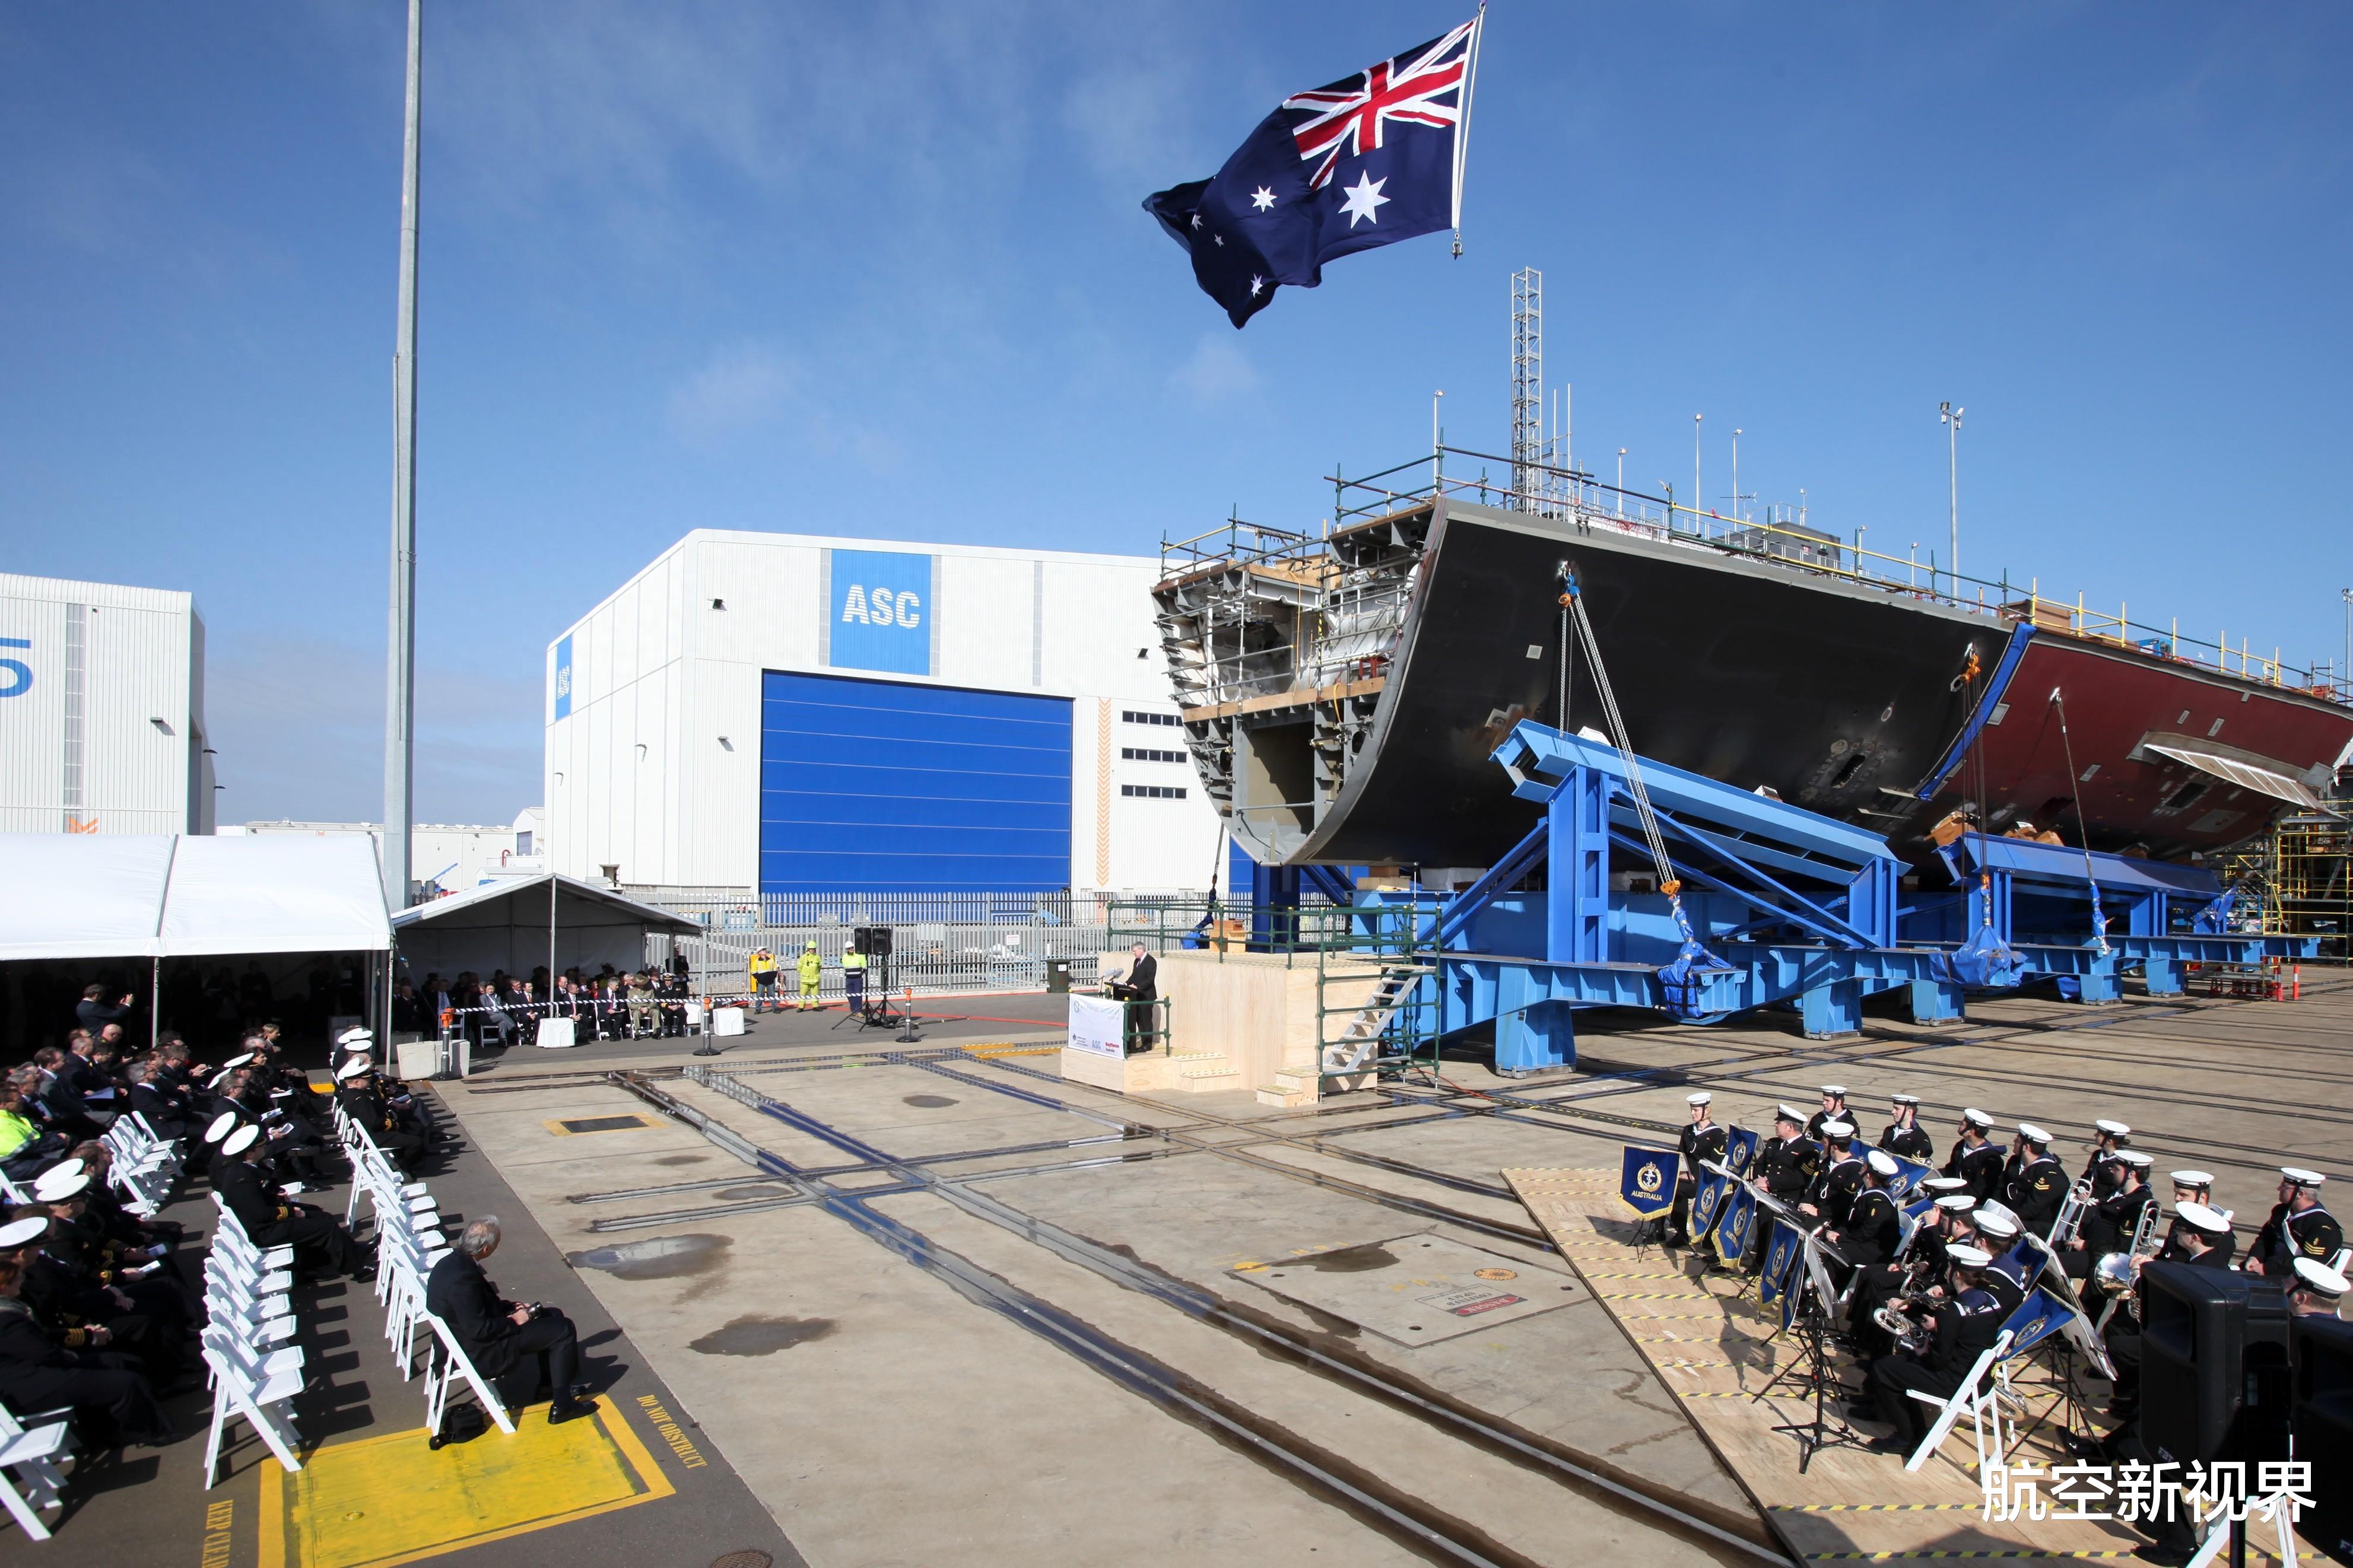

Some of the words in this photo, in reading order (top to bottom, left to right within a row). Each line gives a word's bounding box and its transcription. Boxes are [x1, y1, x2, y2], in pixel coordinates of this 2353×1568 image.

[842, 584, 920, 629] ASC
[557, 664, 570, 700] ASC
[1092, 1040, 1101, 1049] ASC
[1631, 1190, 1662, 1201] AUSTRALIA
[1466, 1297, 1509, 1312] DANGER
[636, 1394, 659, 1407] DO
[645, 1405, 673, 1424] NOT
[658, 1423, 708, 1469] OBSTRUCT
[206, 1499, 233, 1530] KEEP
